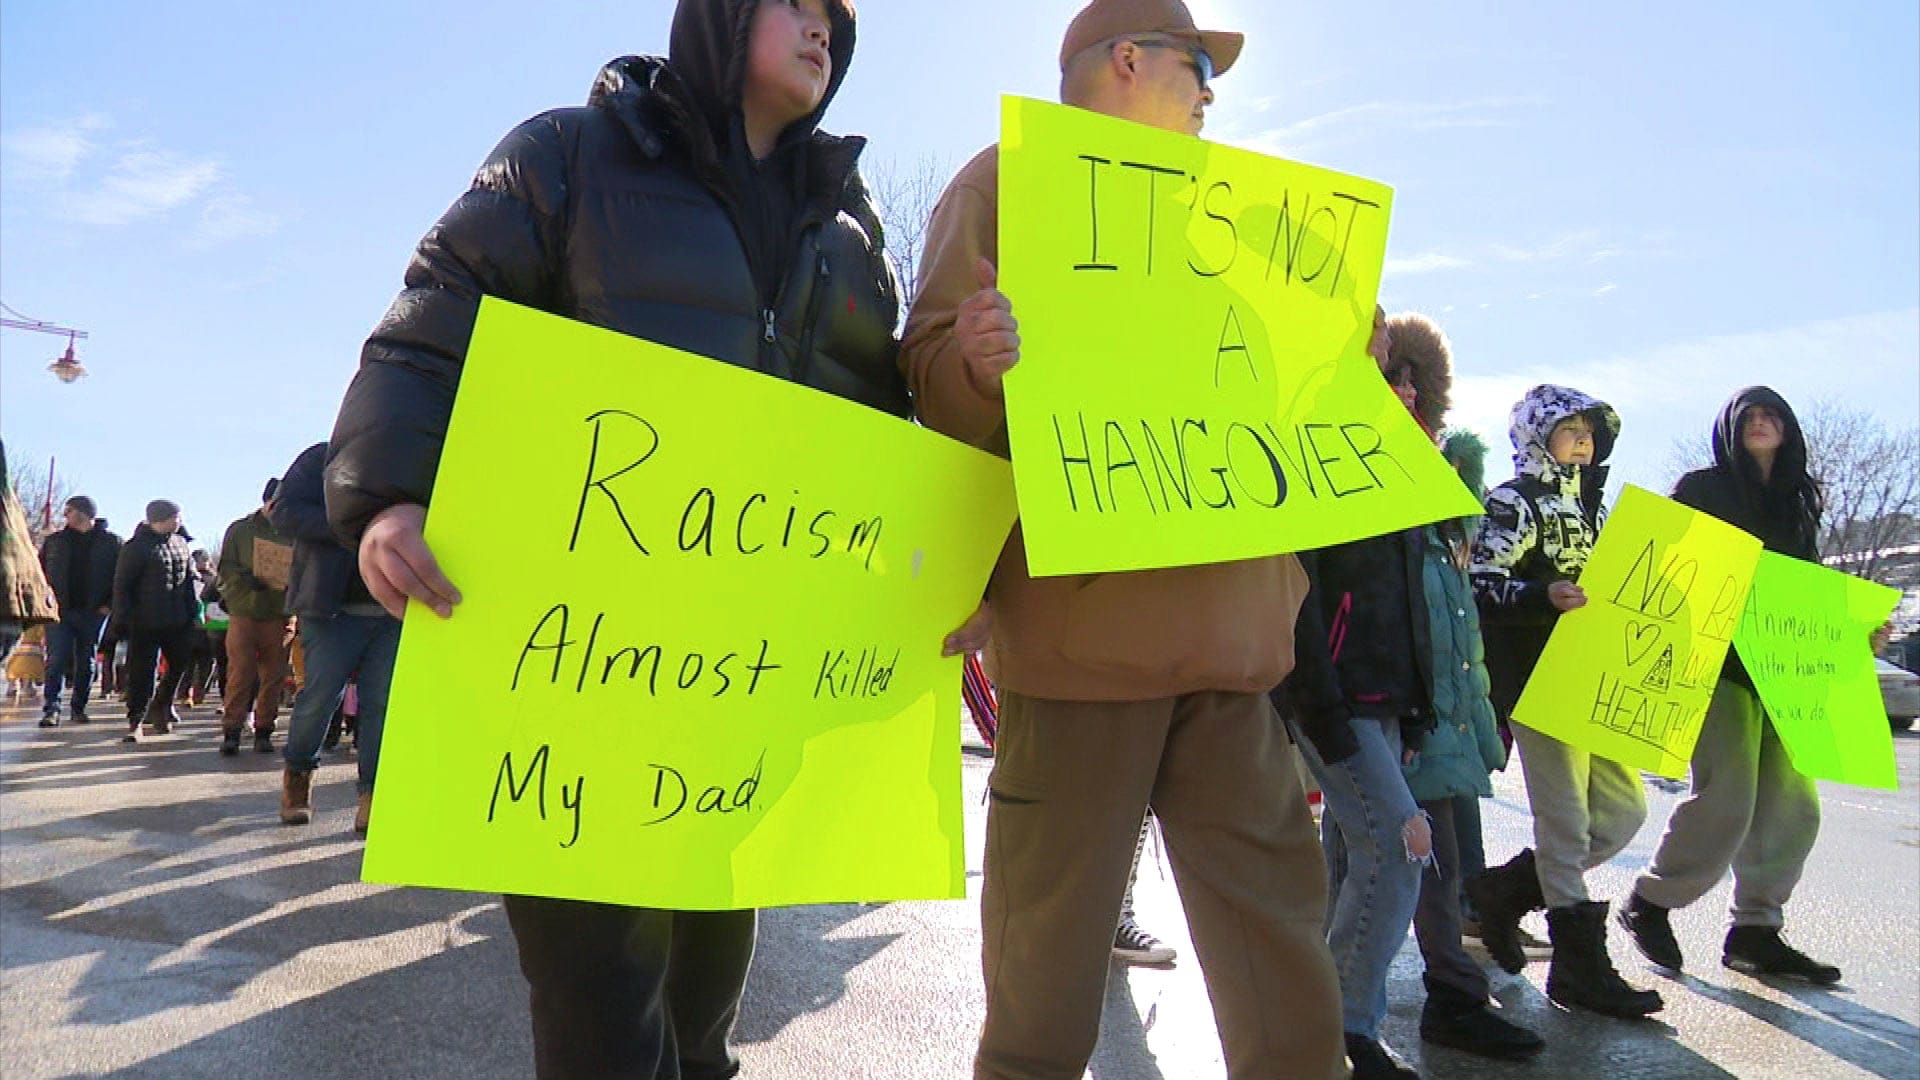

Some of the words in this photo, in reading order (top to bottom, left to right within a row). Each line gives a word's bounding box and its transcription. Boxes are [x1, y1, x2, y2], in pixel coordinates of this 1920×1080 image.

[1073, 155, 1238, 276] IT'S
[1266, 189, 1381, 298] NOT
[1214, 304, 1259, 388] A
[568, 409, 884, 570] Racism
[1053, 411, 1415, 515] HANGOVER
[1613, 538, 1699, 619] NO
[1740, 583, 1819, 643] Animals
[511, 603, 782, 697] Almost
[813, 648, 900, 699] Killed
[487, 745, 584, 849] My
